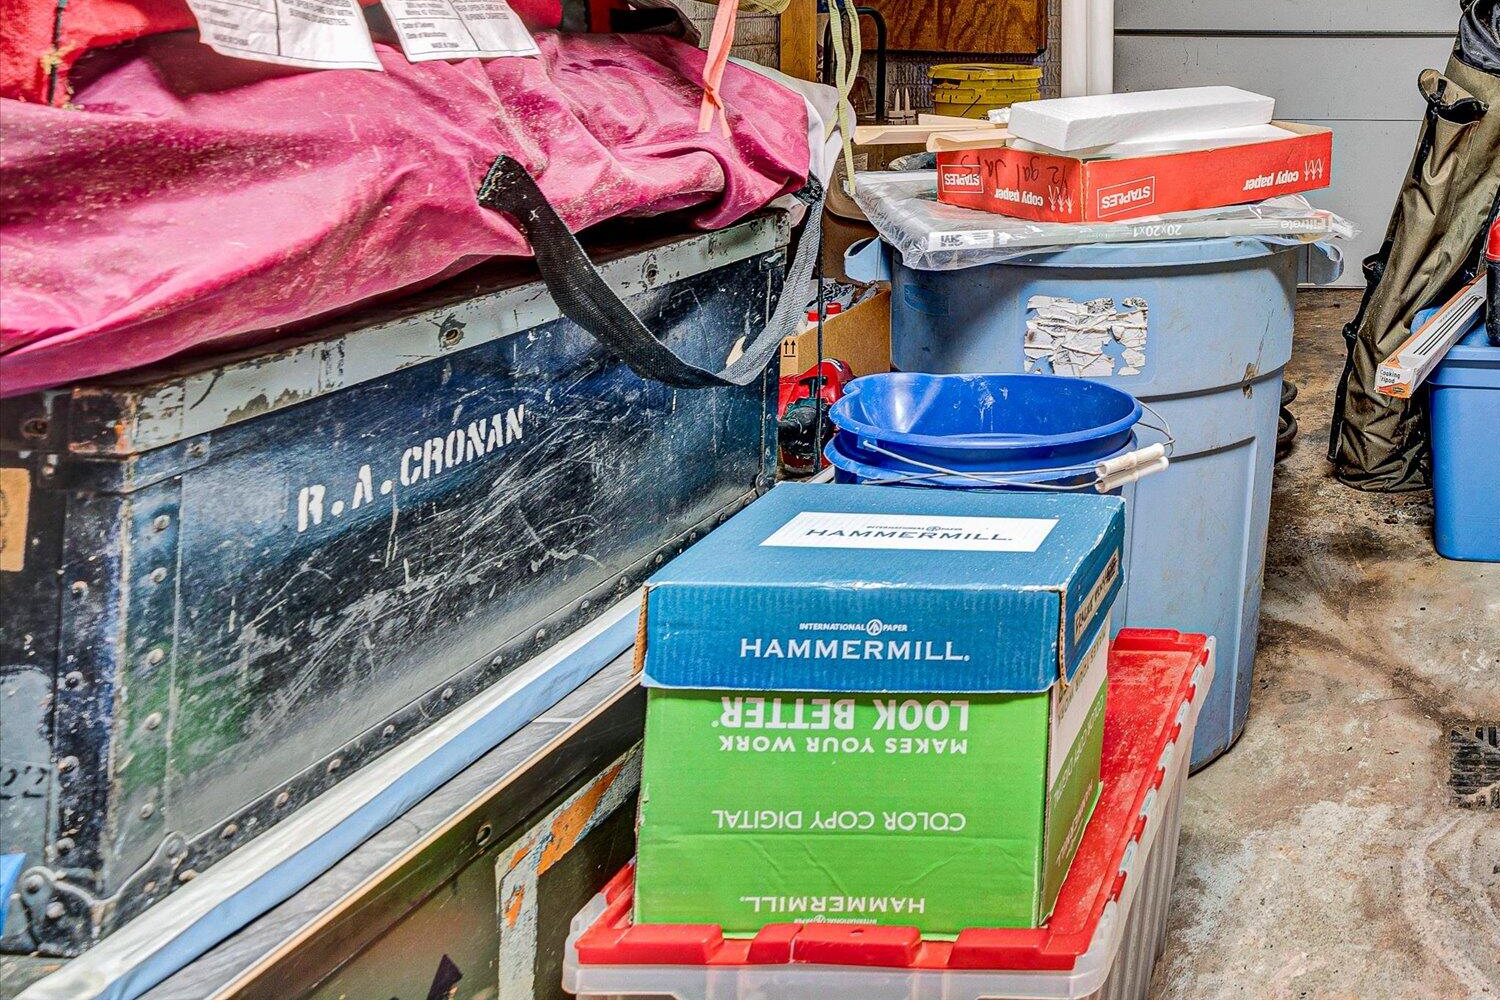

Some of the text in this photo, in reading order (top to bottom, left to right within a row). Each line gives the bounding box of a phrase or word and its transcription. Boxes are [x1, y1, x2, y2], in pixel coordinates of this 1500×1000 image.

[944, 173, 980, 186] STAPLES
[1243, 170, 1299, 191] copy paper
[994, 188, 1043, 206] copy paper
[1101, 185, 1152, 209] STAPLES
[1133, 224, 1182, 238] 20x20x1
[1380, 369, 1400, 379] Cooking
[800, 622, 907, 632] INTERNATIONAL PAPER
[873, 699, 969, 732] LOOK
[719, 735, 967, 754] MAKES YOUR WORK
[711, 810, 966, 831] COLOR COPY DIGITAL
